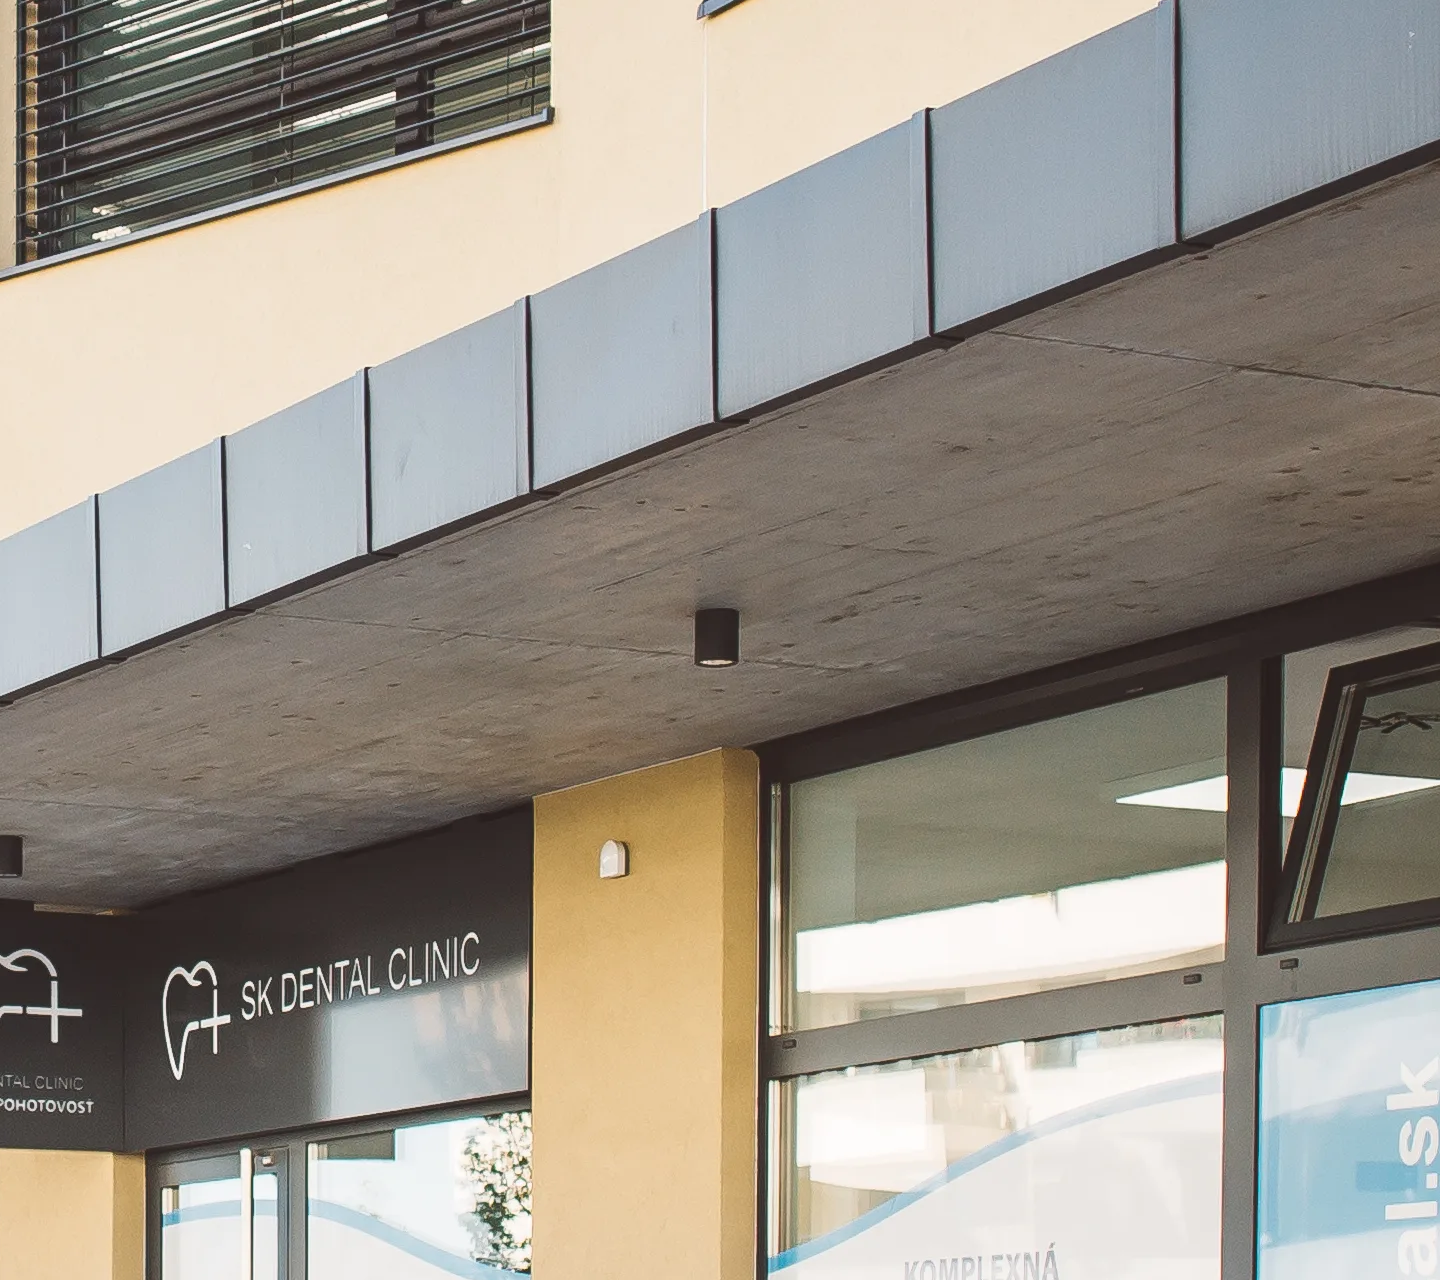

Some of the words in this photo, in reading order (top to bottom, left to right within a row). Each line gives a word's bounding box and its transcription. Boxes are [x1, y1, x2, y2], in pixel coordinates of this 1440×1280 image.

[241, 976, 273, 1020] SK
[281, 956, 381, 1013] DENTAL
[388, 931, 480, 991] CLINIC
[35, 1075, 84, 1091] CLINIC
